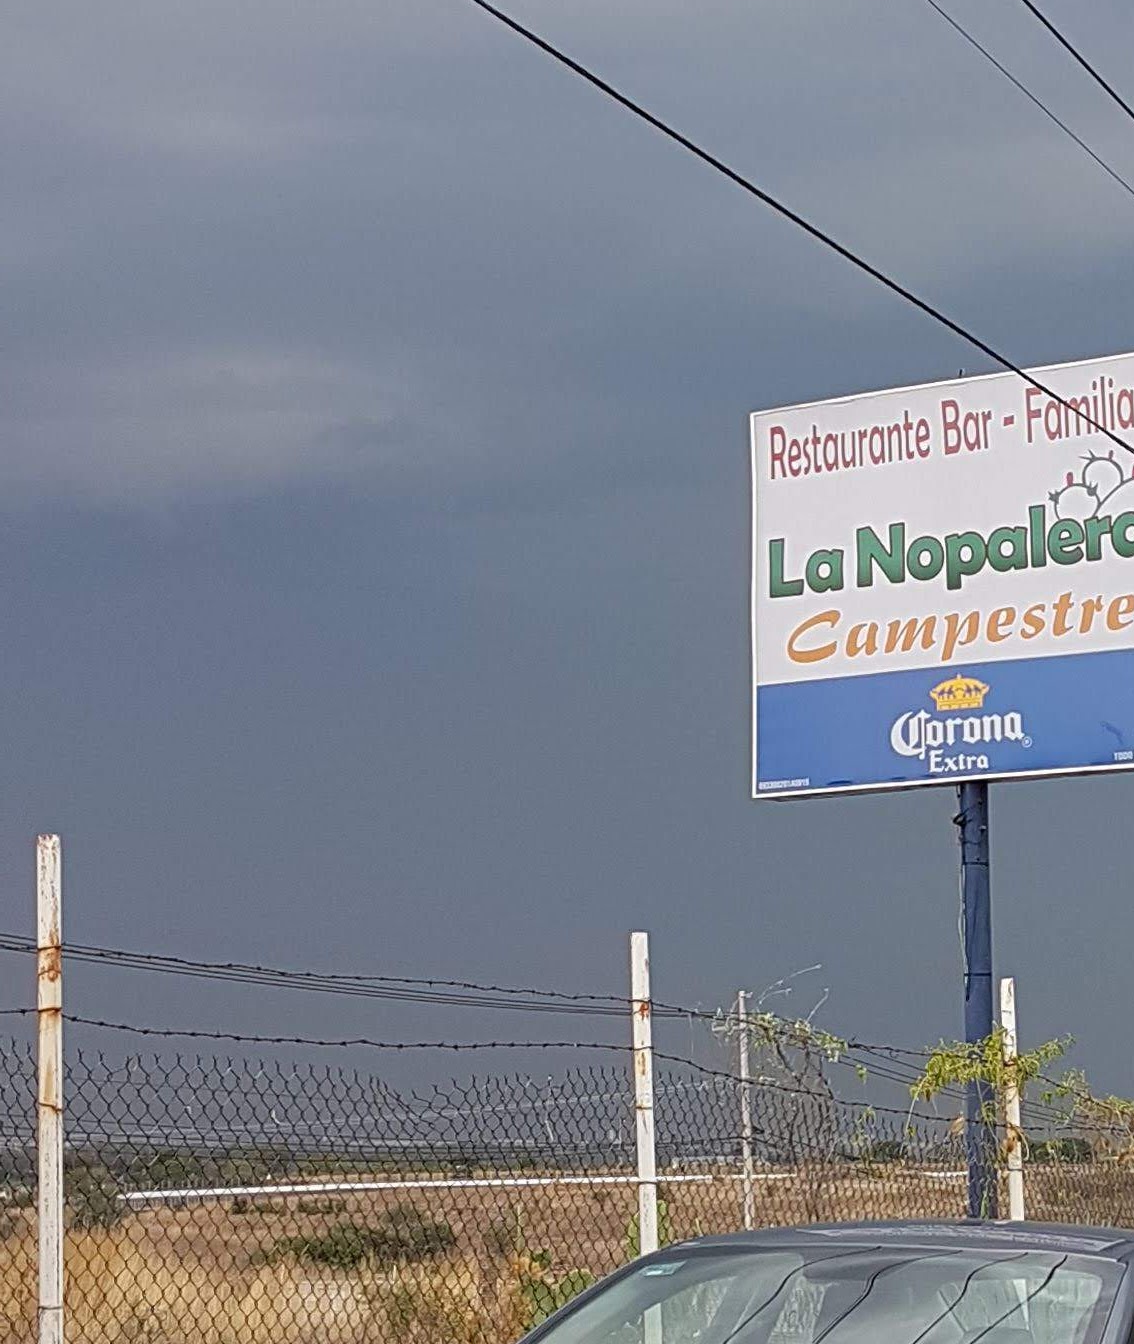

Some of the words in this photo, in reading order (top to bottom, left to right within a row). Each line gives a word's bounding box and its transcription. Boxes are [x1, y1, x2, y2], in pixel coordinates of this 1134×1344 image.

[769, 410, 931, 480] Restaurante
[941, 399, 993, 456] Bar
[768, 538, 844, 599] La
[890, 709, 1025, 760] Corona
[929, 749, 990, 773] Extra
